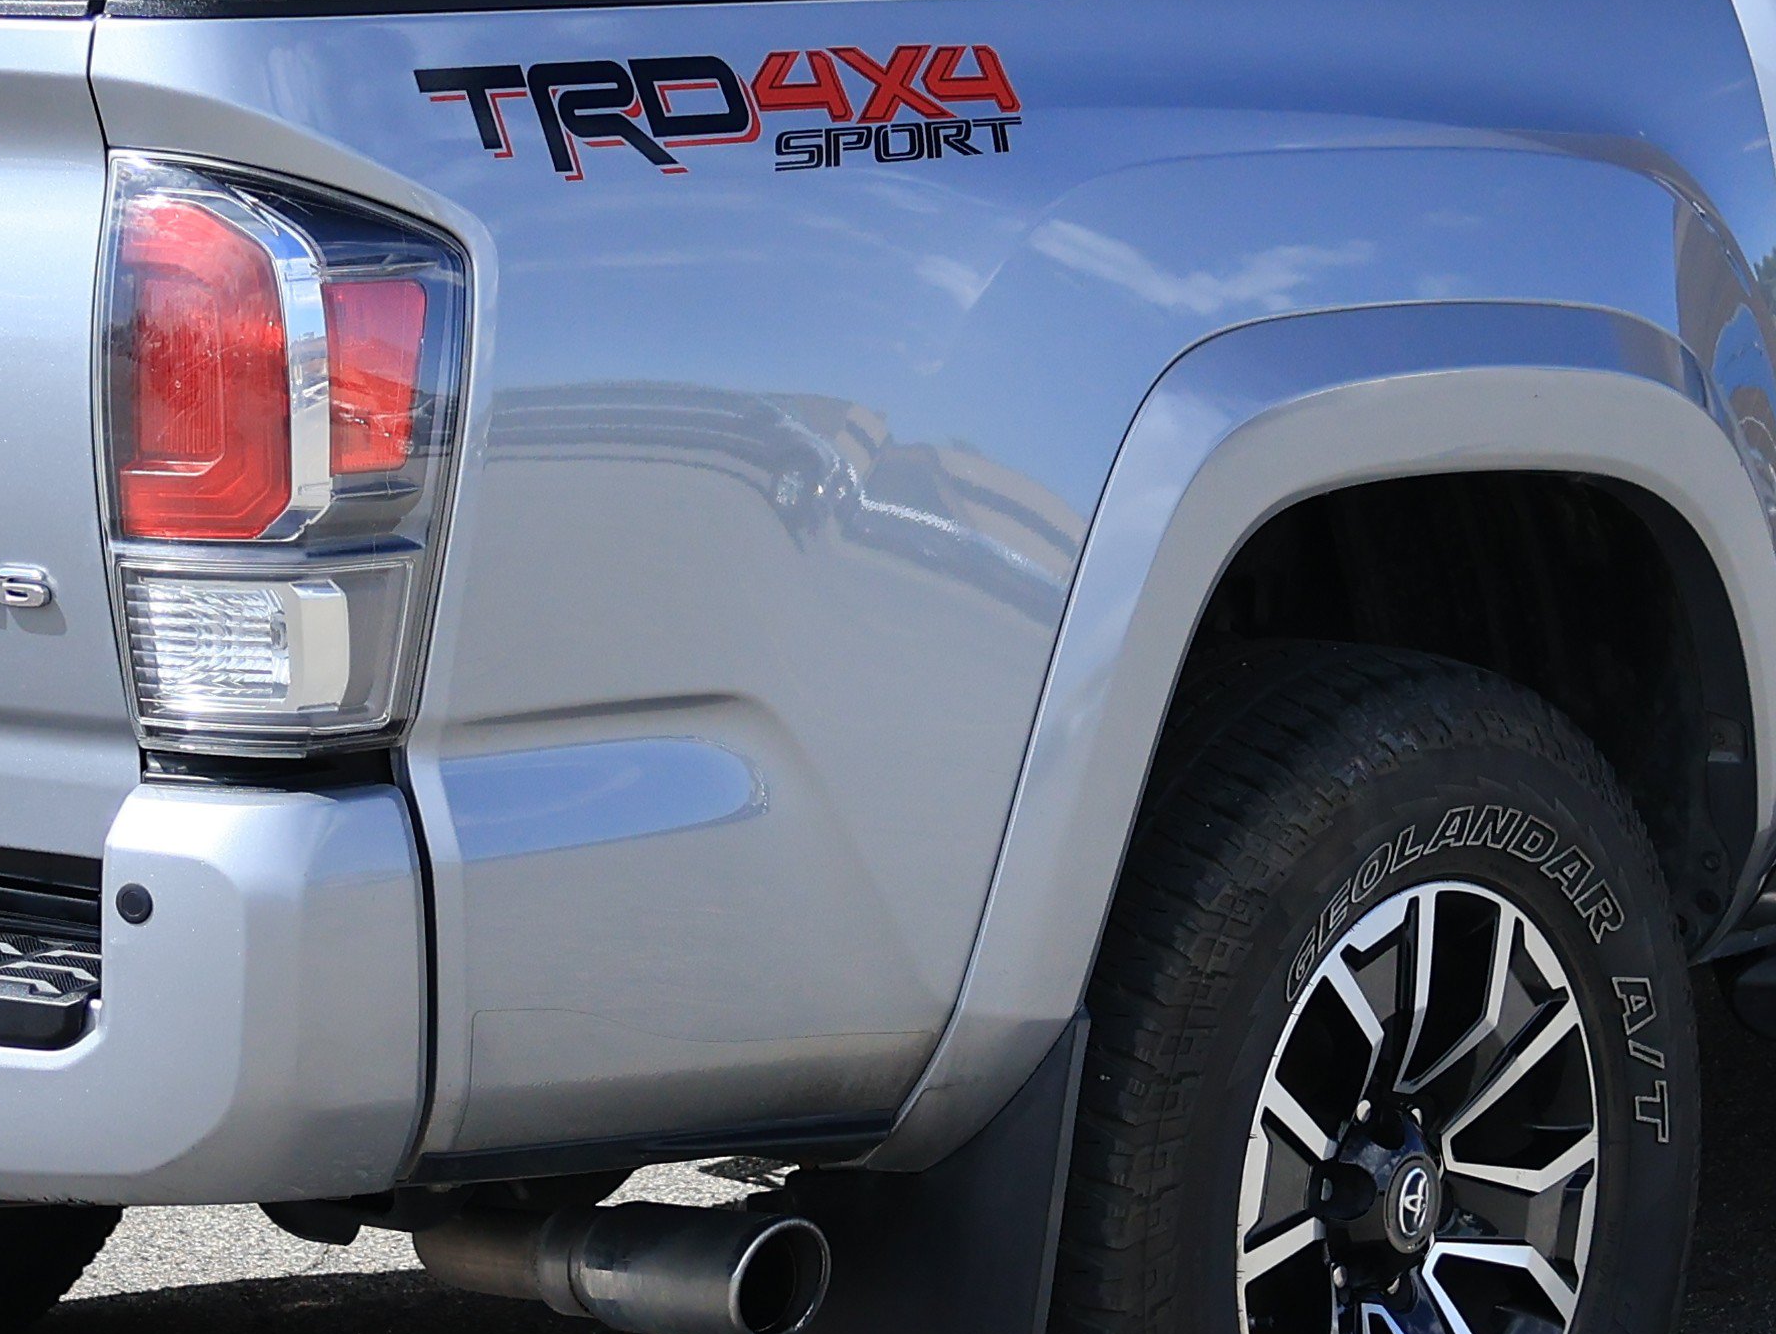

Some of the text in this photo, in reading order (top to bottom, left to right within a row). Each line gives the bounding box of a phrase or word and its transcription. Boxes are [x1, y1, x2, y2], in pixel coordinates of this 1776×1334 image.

[413, 44, 1022, 181] TRD 4X4
[774, 116, 1023, 172] SPORT
[1285, 804, 1670, 1144] GEOLANDAR A/T
